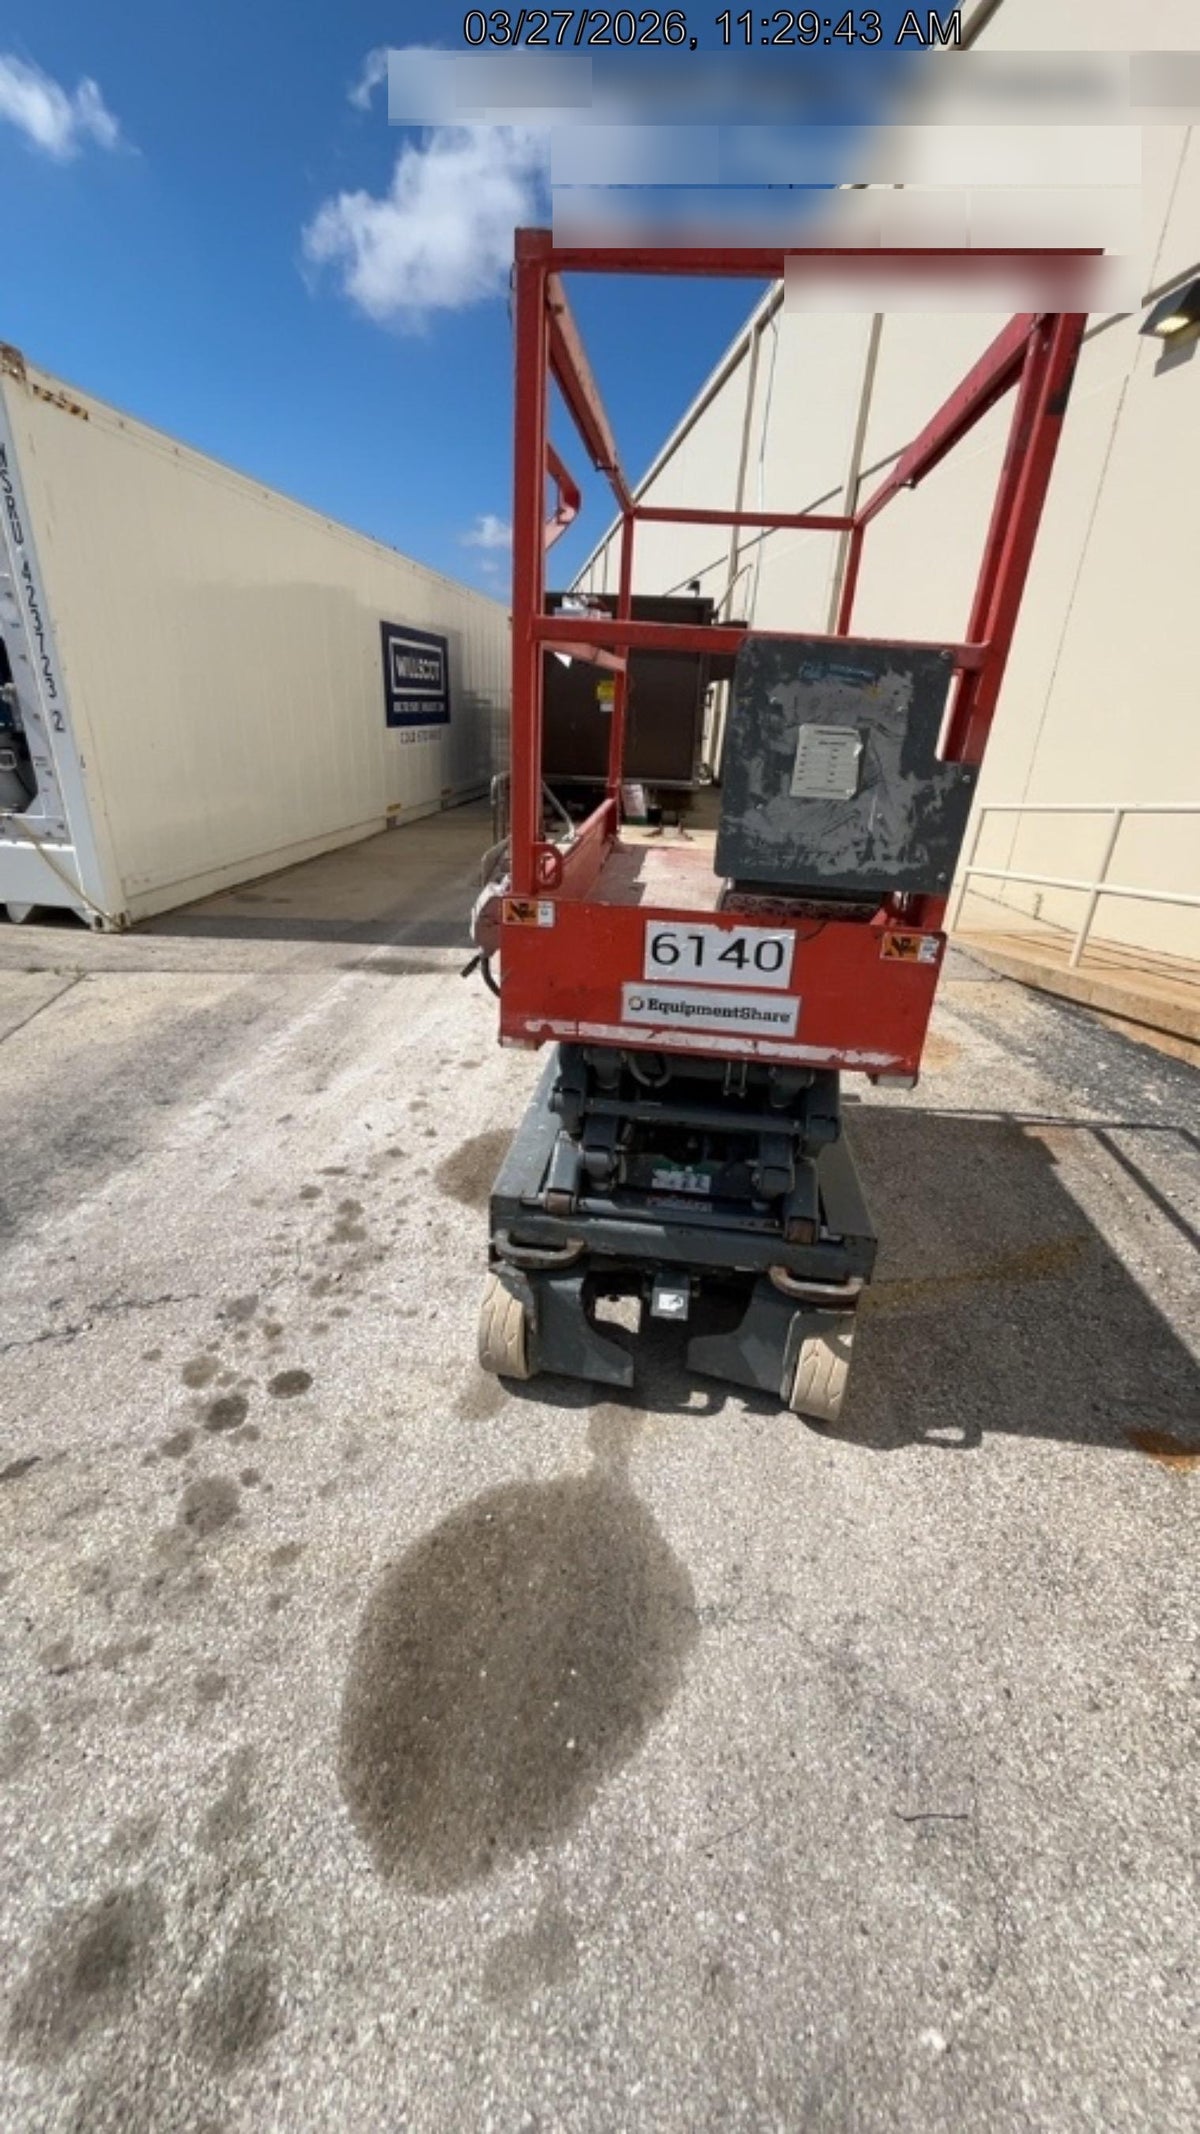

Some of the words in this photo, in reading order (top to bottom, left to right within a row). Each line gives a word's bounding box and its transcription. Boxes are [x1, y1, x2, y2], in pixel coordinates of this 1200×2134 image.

[52, 710, 65, 732] 2
[651, 932, 785, 972] 6140
[648, 997, 791, 1023] EquipmentShare
